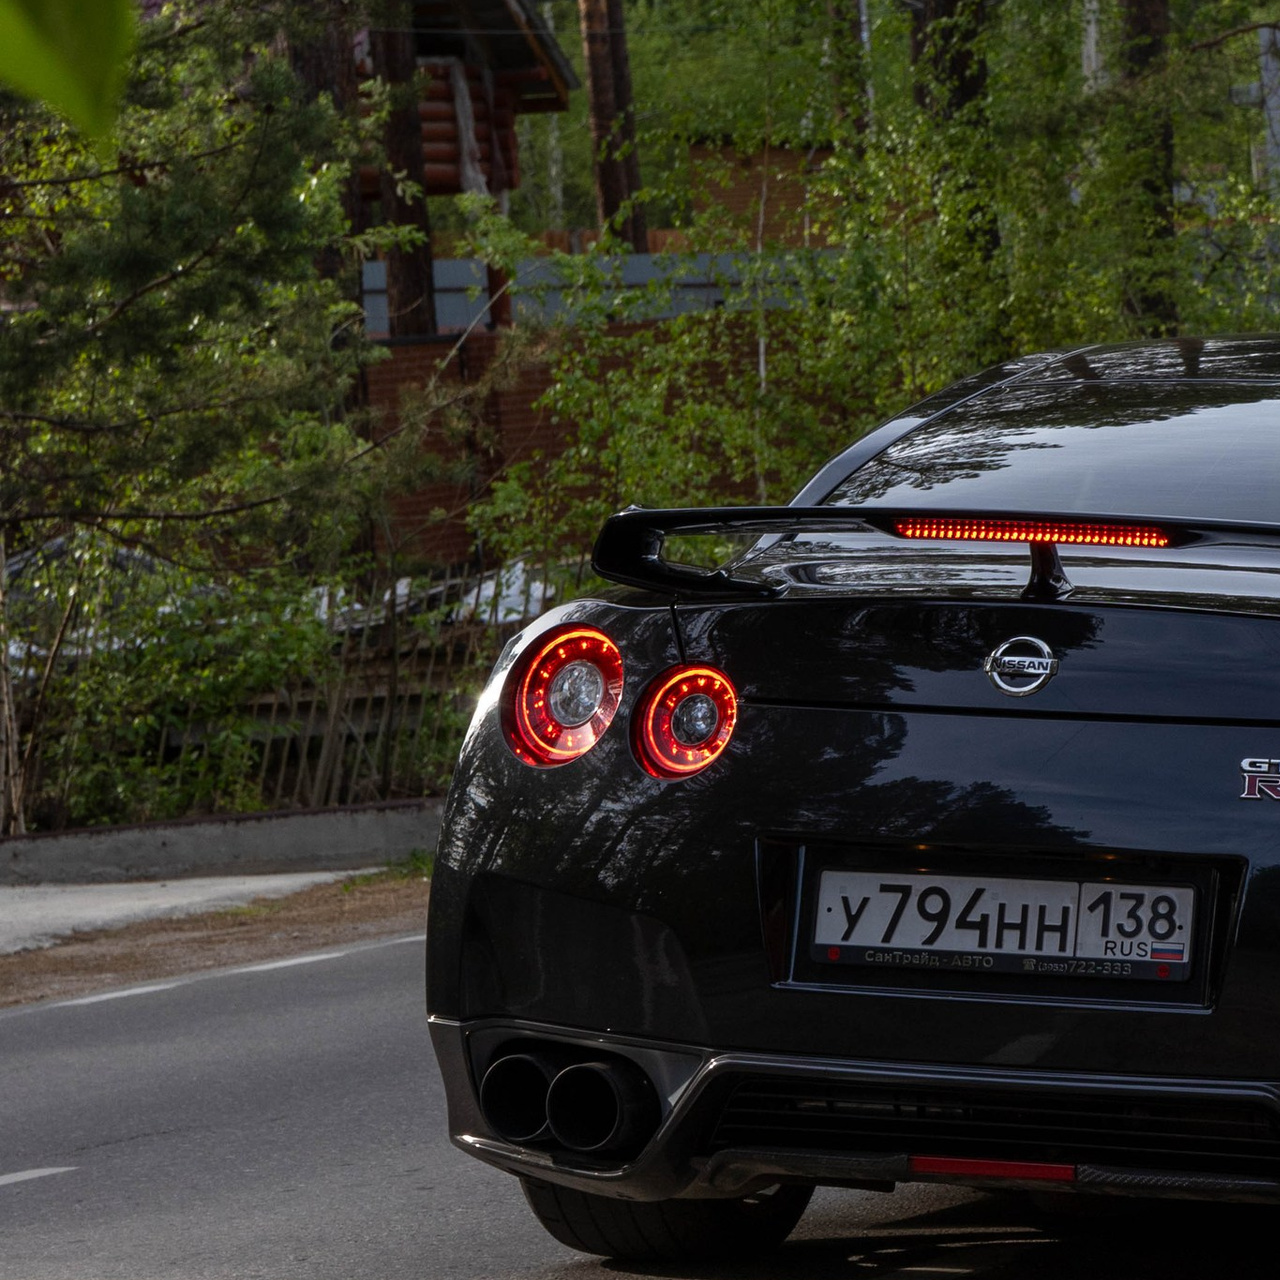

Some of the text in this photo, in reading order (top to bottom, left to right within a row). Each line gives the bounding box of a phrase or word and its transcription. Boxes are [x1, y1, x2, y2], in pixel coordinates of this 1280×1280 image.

[991, 659, 1049, 671] NISSAN
[1087, 891, 1177, 940] 138
[1104, 940, 1149, 958] RUS
[864, 950, 940, 967] СанТрейд
[951, 955, 994, 968] АВТО
